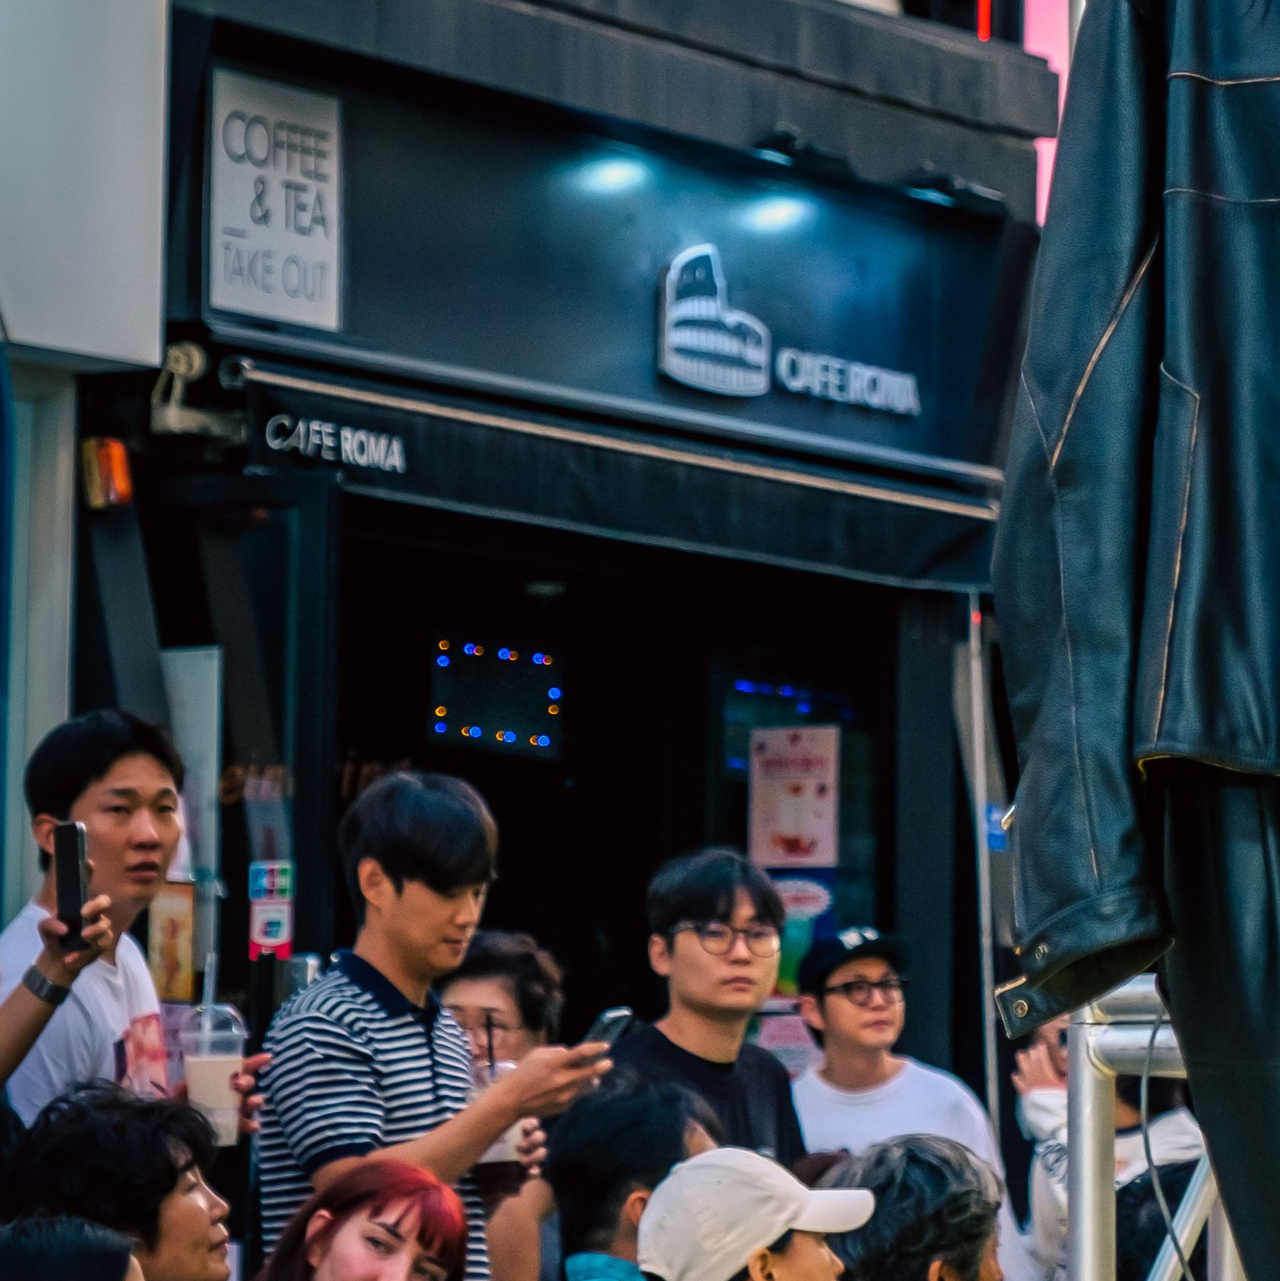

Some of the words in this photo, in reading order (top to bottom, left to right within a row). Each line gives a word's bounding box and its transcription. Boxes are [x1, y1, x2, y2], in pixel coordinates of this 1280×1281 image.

[222, 110, 330, 183] COFFEE
[250, 174, 273, 227] &
[281, 178, 331, 241] TEA
[221, 240, 277, 296] TAKE
[281, 253, 331, 302] OUT
[265, 414, 338, 461] CAFE
[340, 426, 407, 473] ROMA
